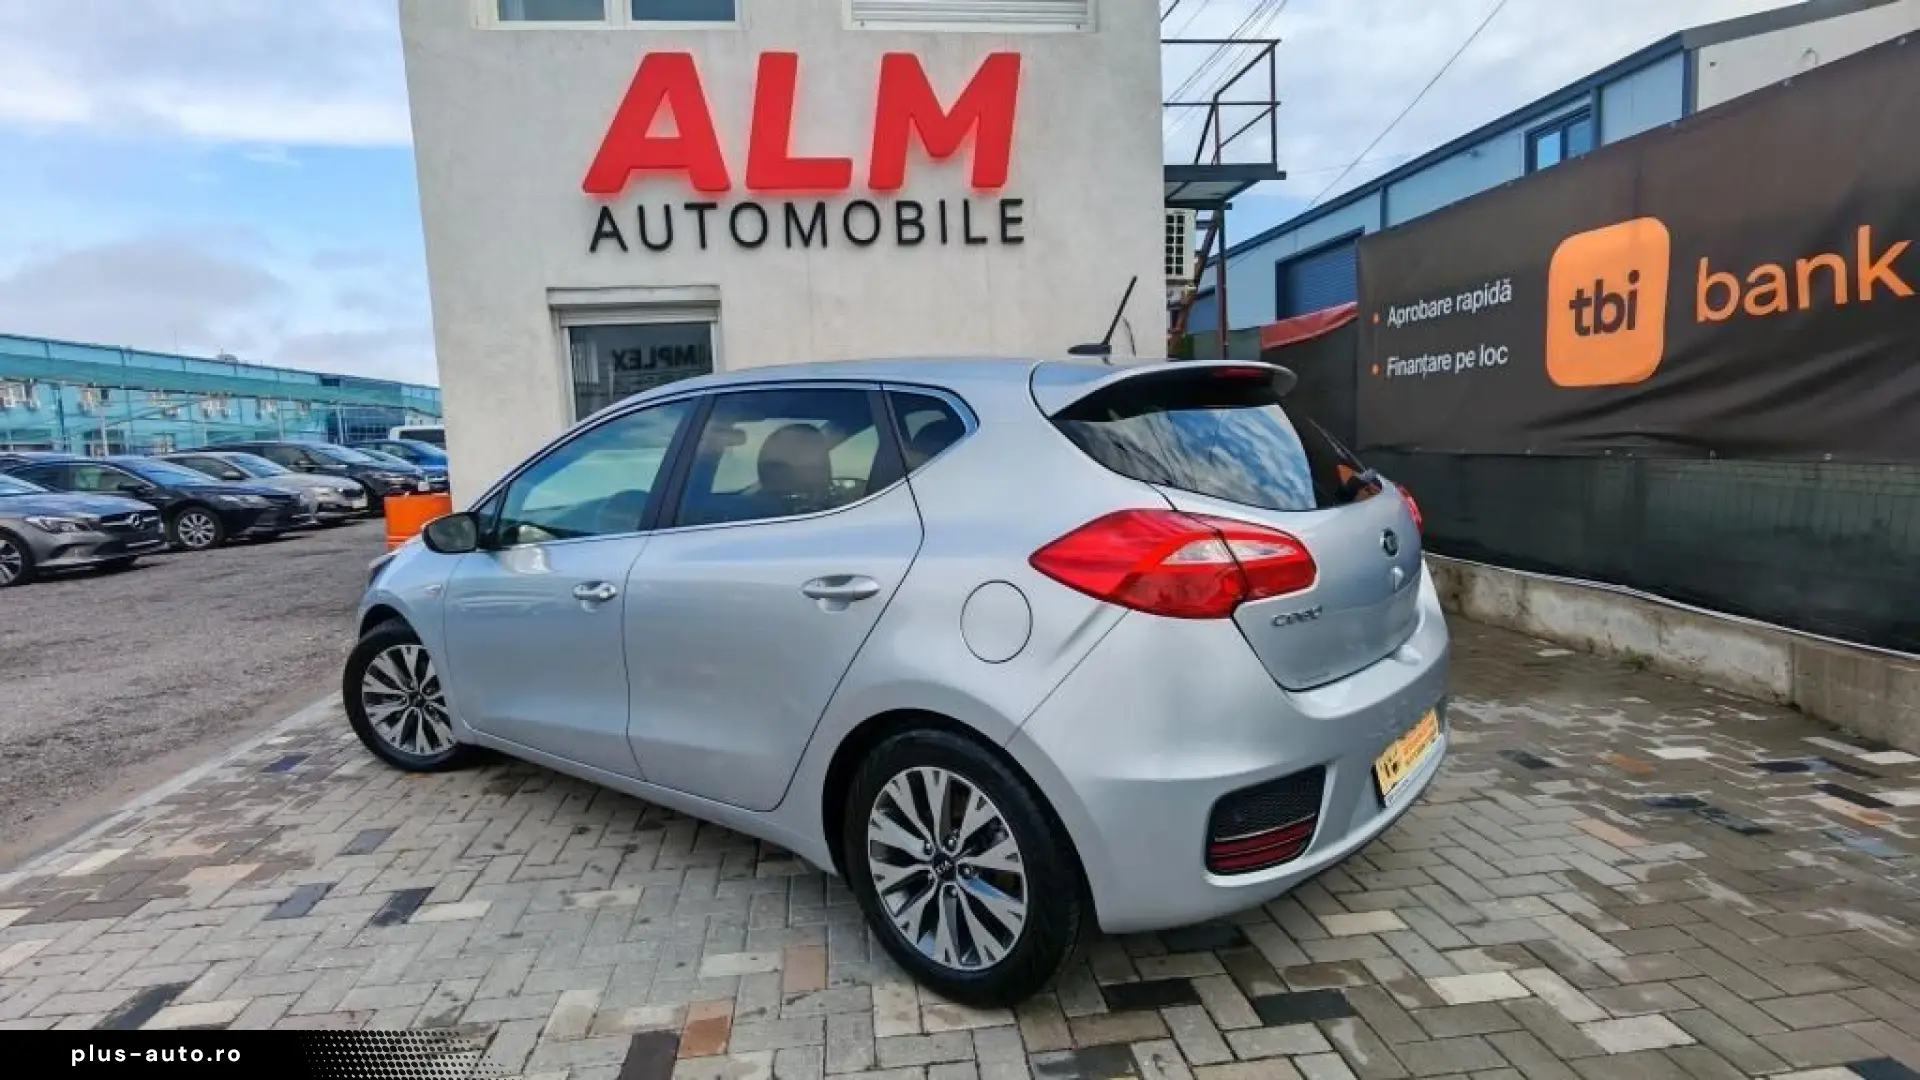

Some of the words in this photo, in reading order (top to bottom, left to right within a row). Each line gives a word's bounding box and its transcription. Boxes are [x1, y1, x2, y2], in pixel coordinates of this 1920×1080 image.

[582, 51, 1021, 194] ALM
[589, 198, 1024, 254] AUTOMOBILE
[1387, 296, 1452, 329] Aprobare
[1456, 277, 1513, 314] rapidă
[1568, 269, 1640, 337] tbi
[1697, 224, 1915, 323] bank
[1455, 349, 1476, 374] pe
[1478, 343, 1509, 367] loc
